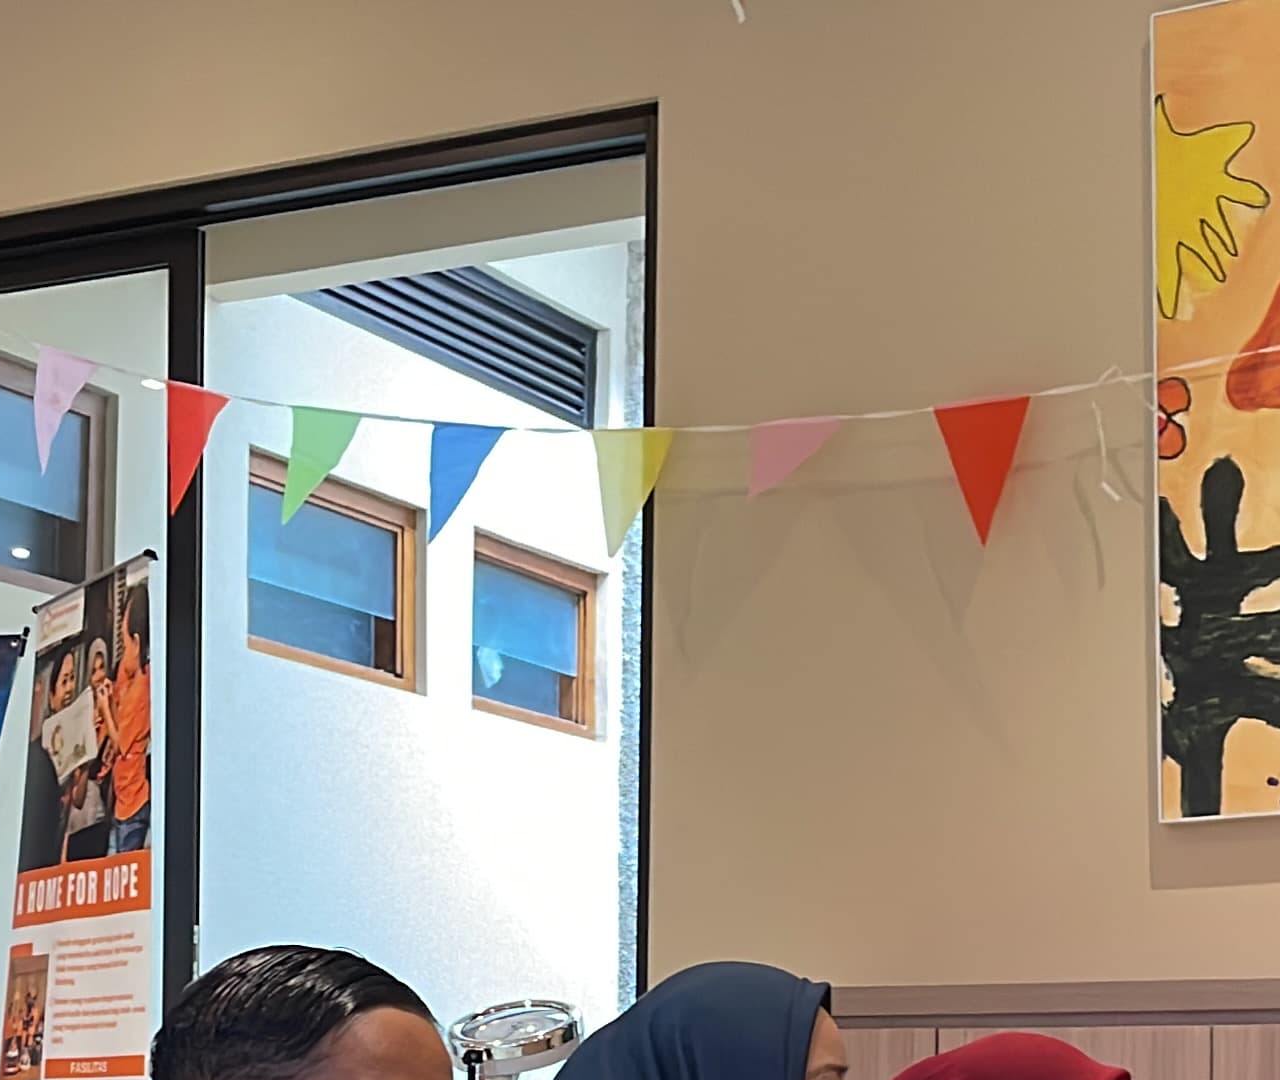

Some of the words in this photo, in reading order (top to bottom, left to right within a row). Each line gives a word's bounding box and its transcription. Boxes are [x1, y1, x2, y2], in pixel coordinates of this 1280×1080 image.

[26, 875, 65, 914] HOME
[66, 870, 98, 907] FOR
[103, 862, 139, 903] HOPE
